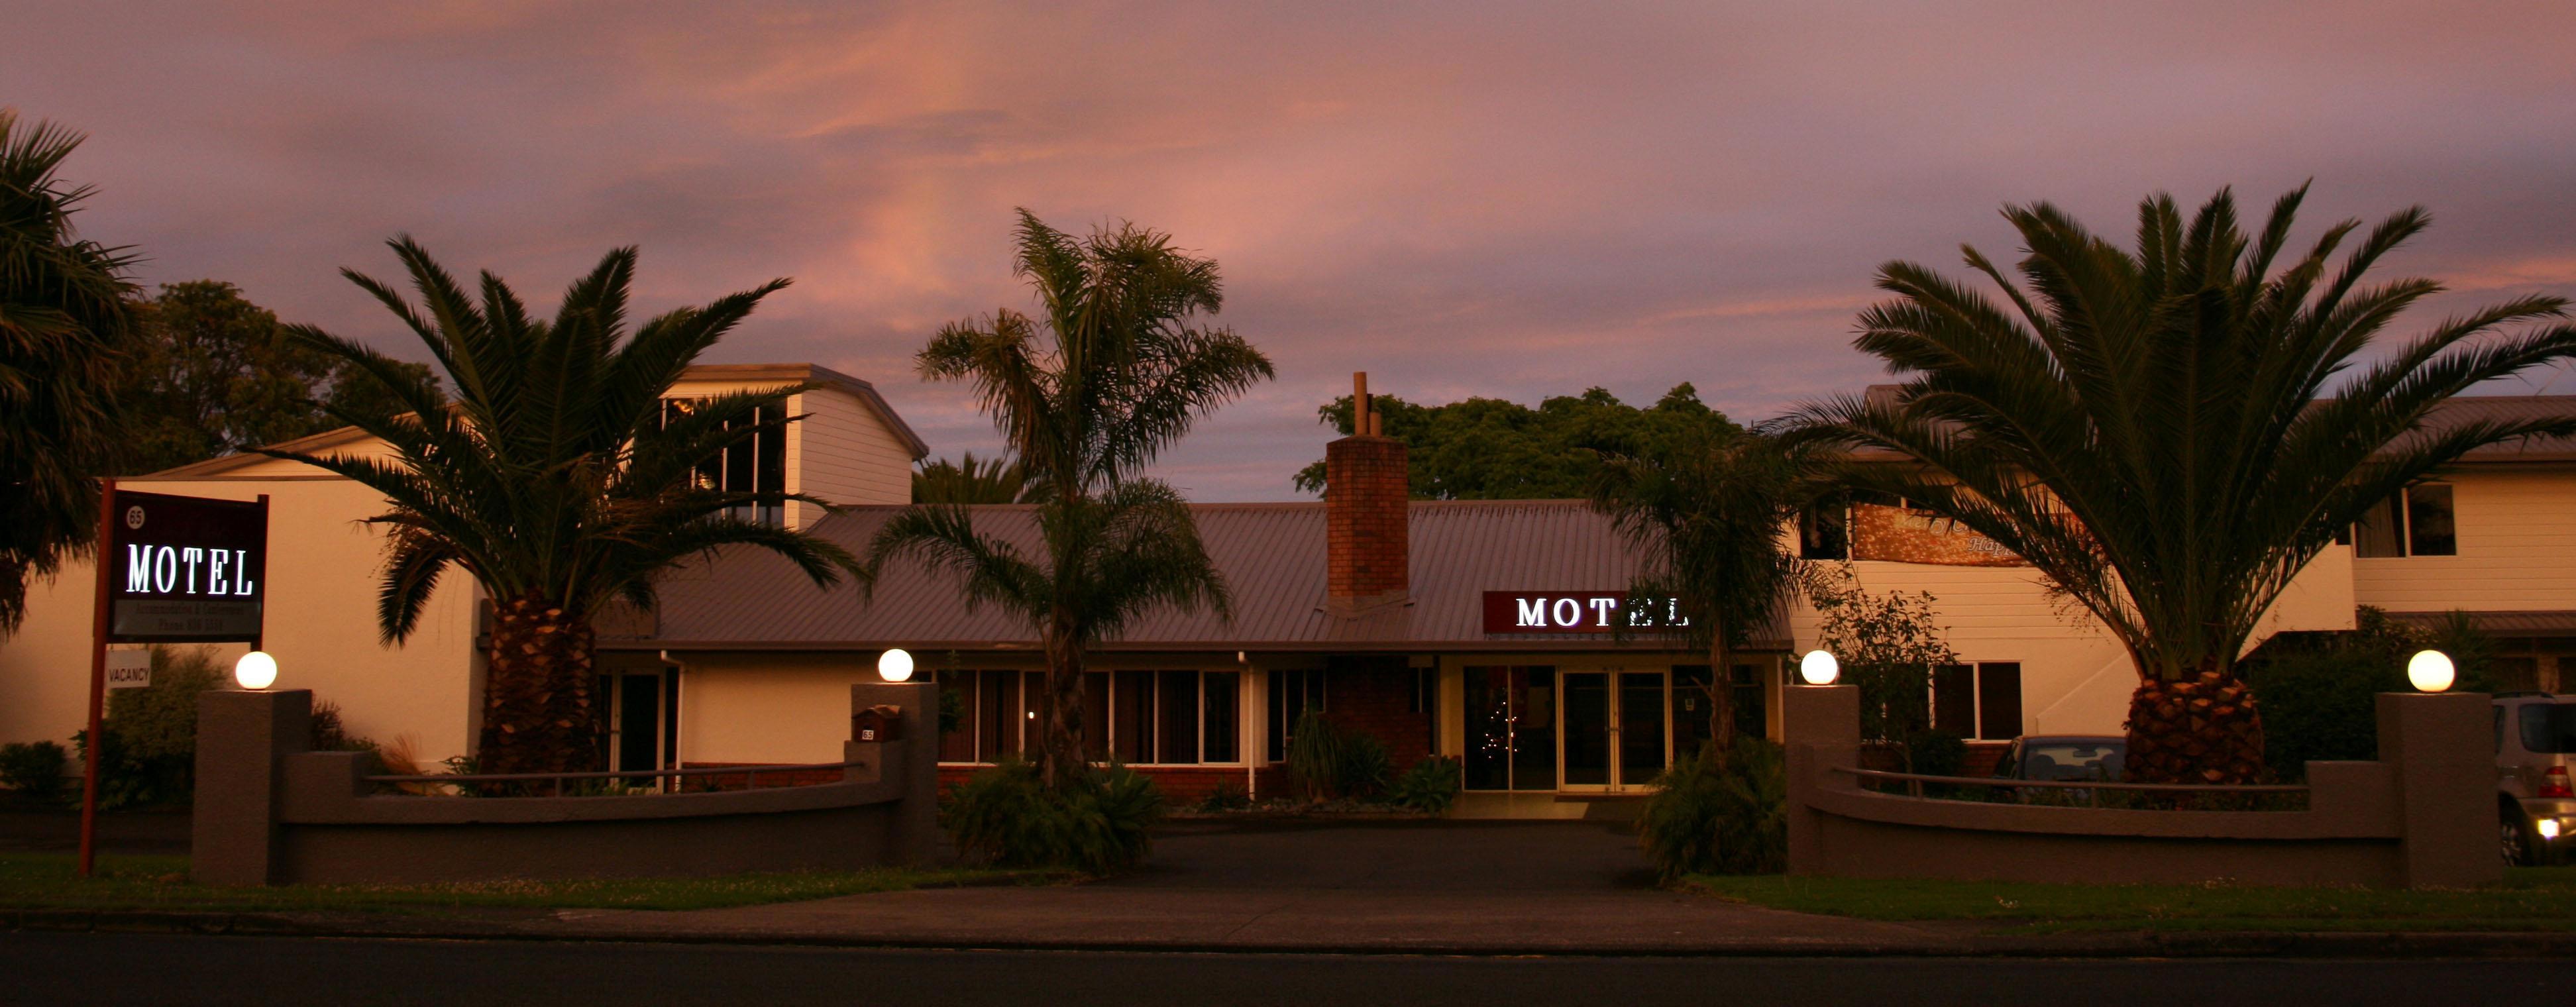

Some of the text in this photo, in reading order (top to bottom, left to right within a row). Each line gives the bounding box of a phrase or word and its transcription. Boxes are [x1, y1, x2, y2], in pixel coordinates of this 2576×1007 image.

[130, 510, 142, 524] 65
[126, 543, 253, 596] MOTEL
[109, 668, 150, 682] VACANCY
